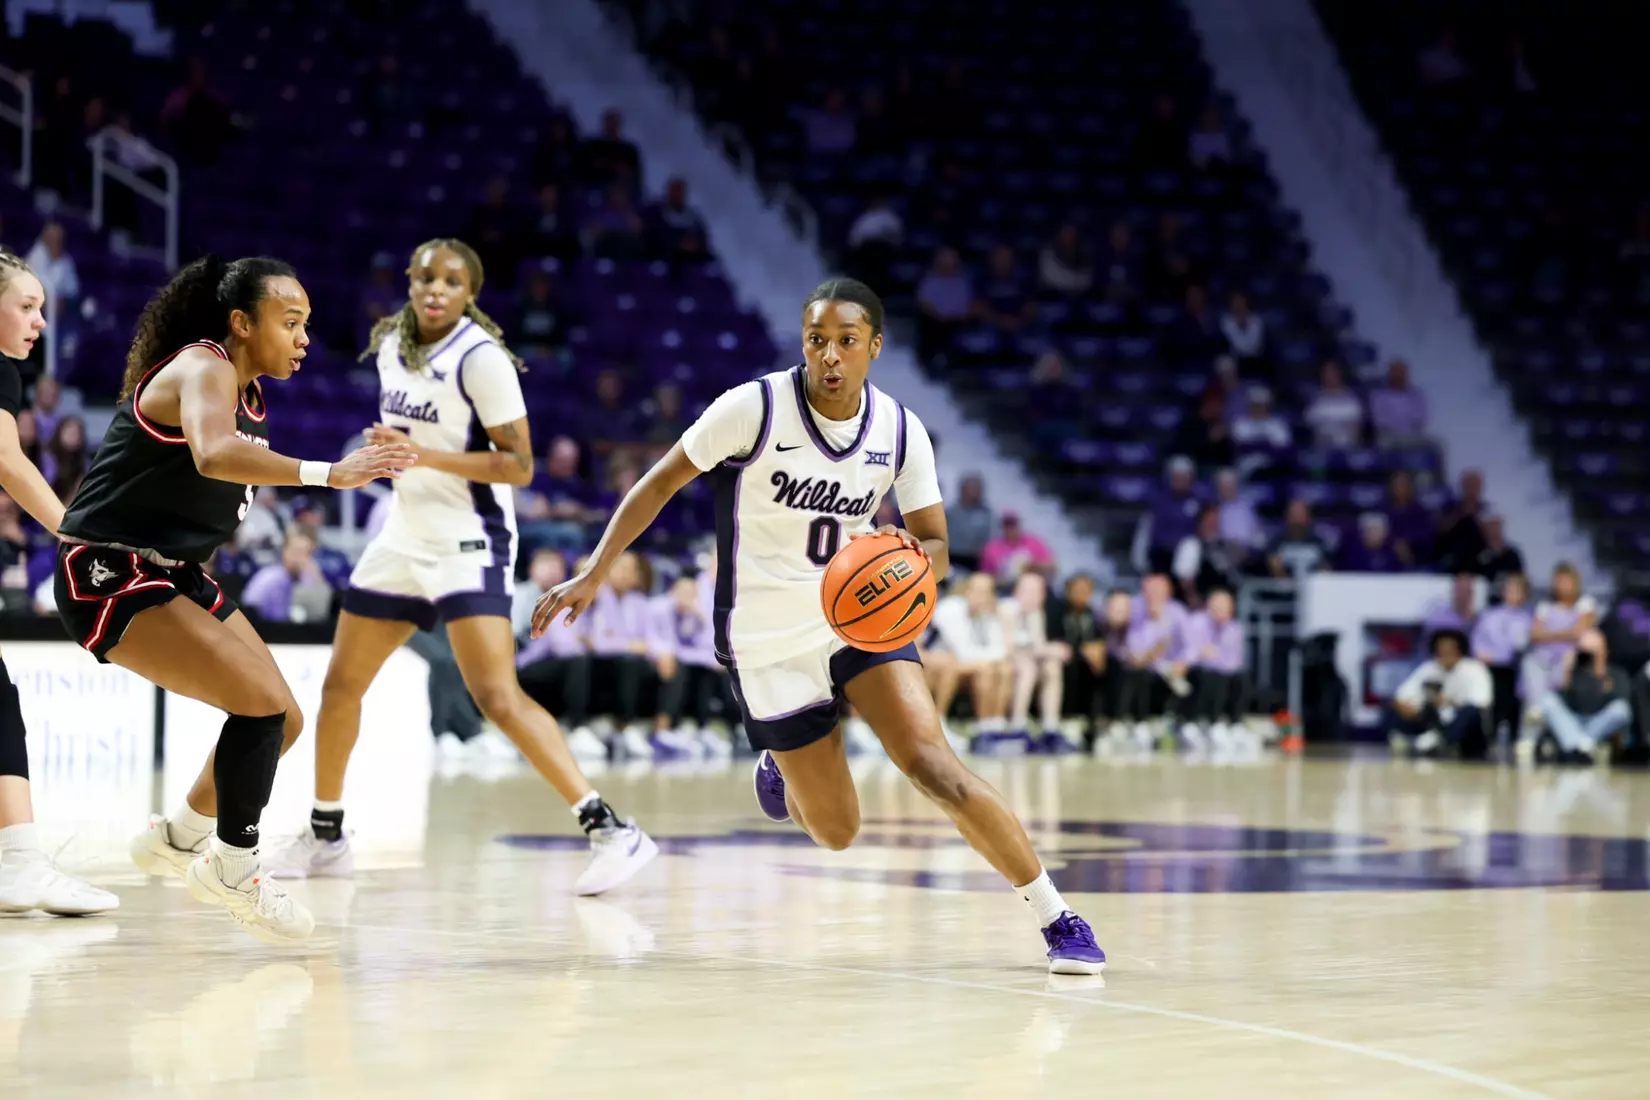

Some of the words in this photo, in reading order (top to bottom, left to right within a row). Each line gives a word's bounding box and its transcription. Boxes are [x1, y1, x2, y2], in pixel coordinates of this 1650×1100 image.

[865, 451, 890, 466] XII
[771, 470, 875, 516] Wildcat
[806, 515, 841, 568] 0
[854, 559, 914, 607] ELITE
